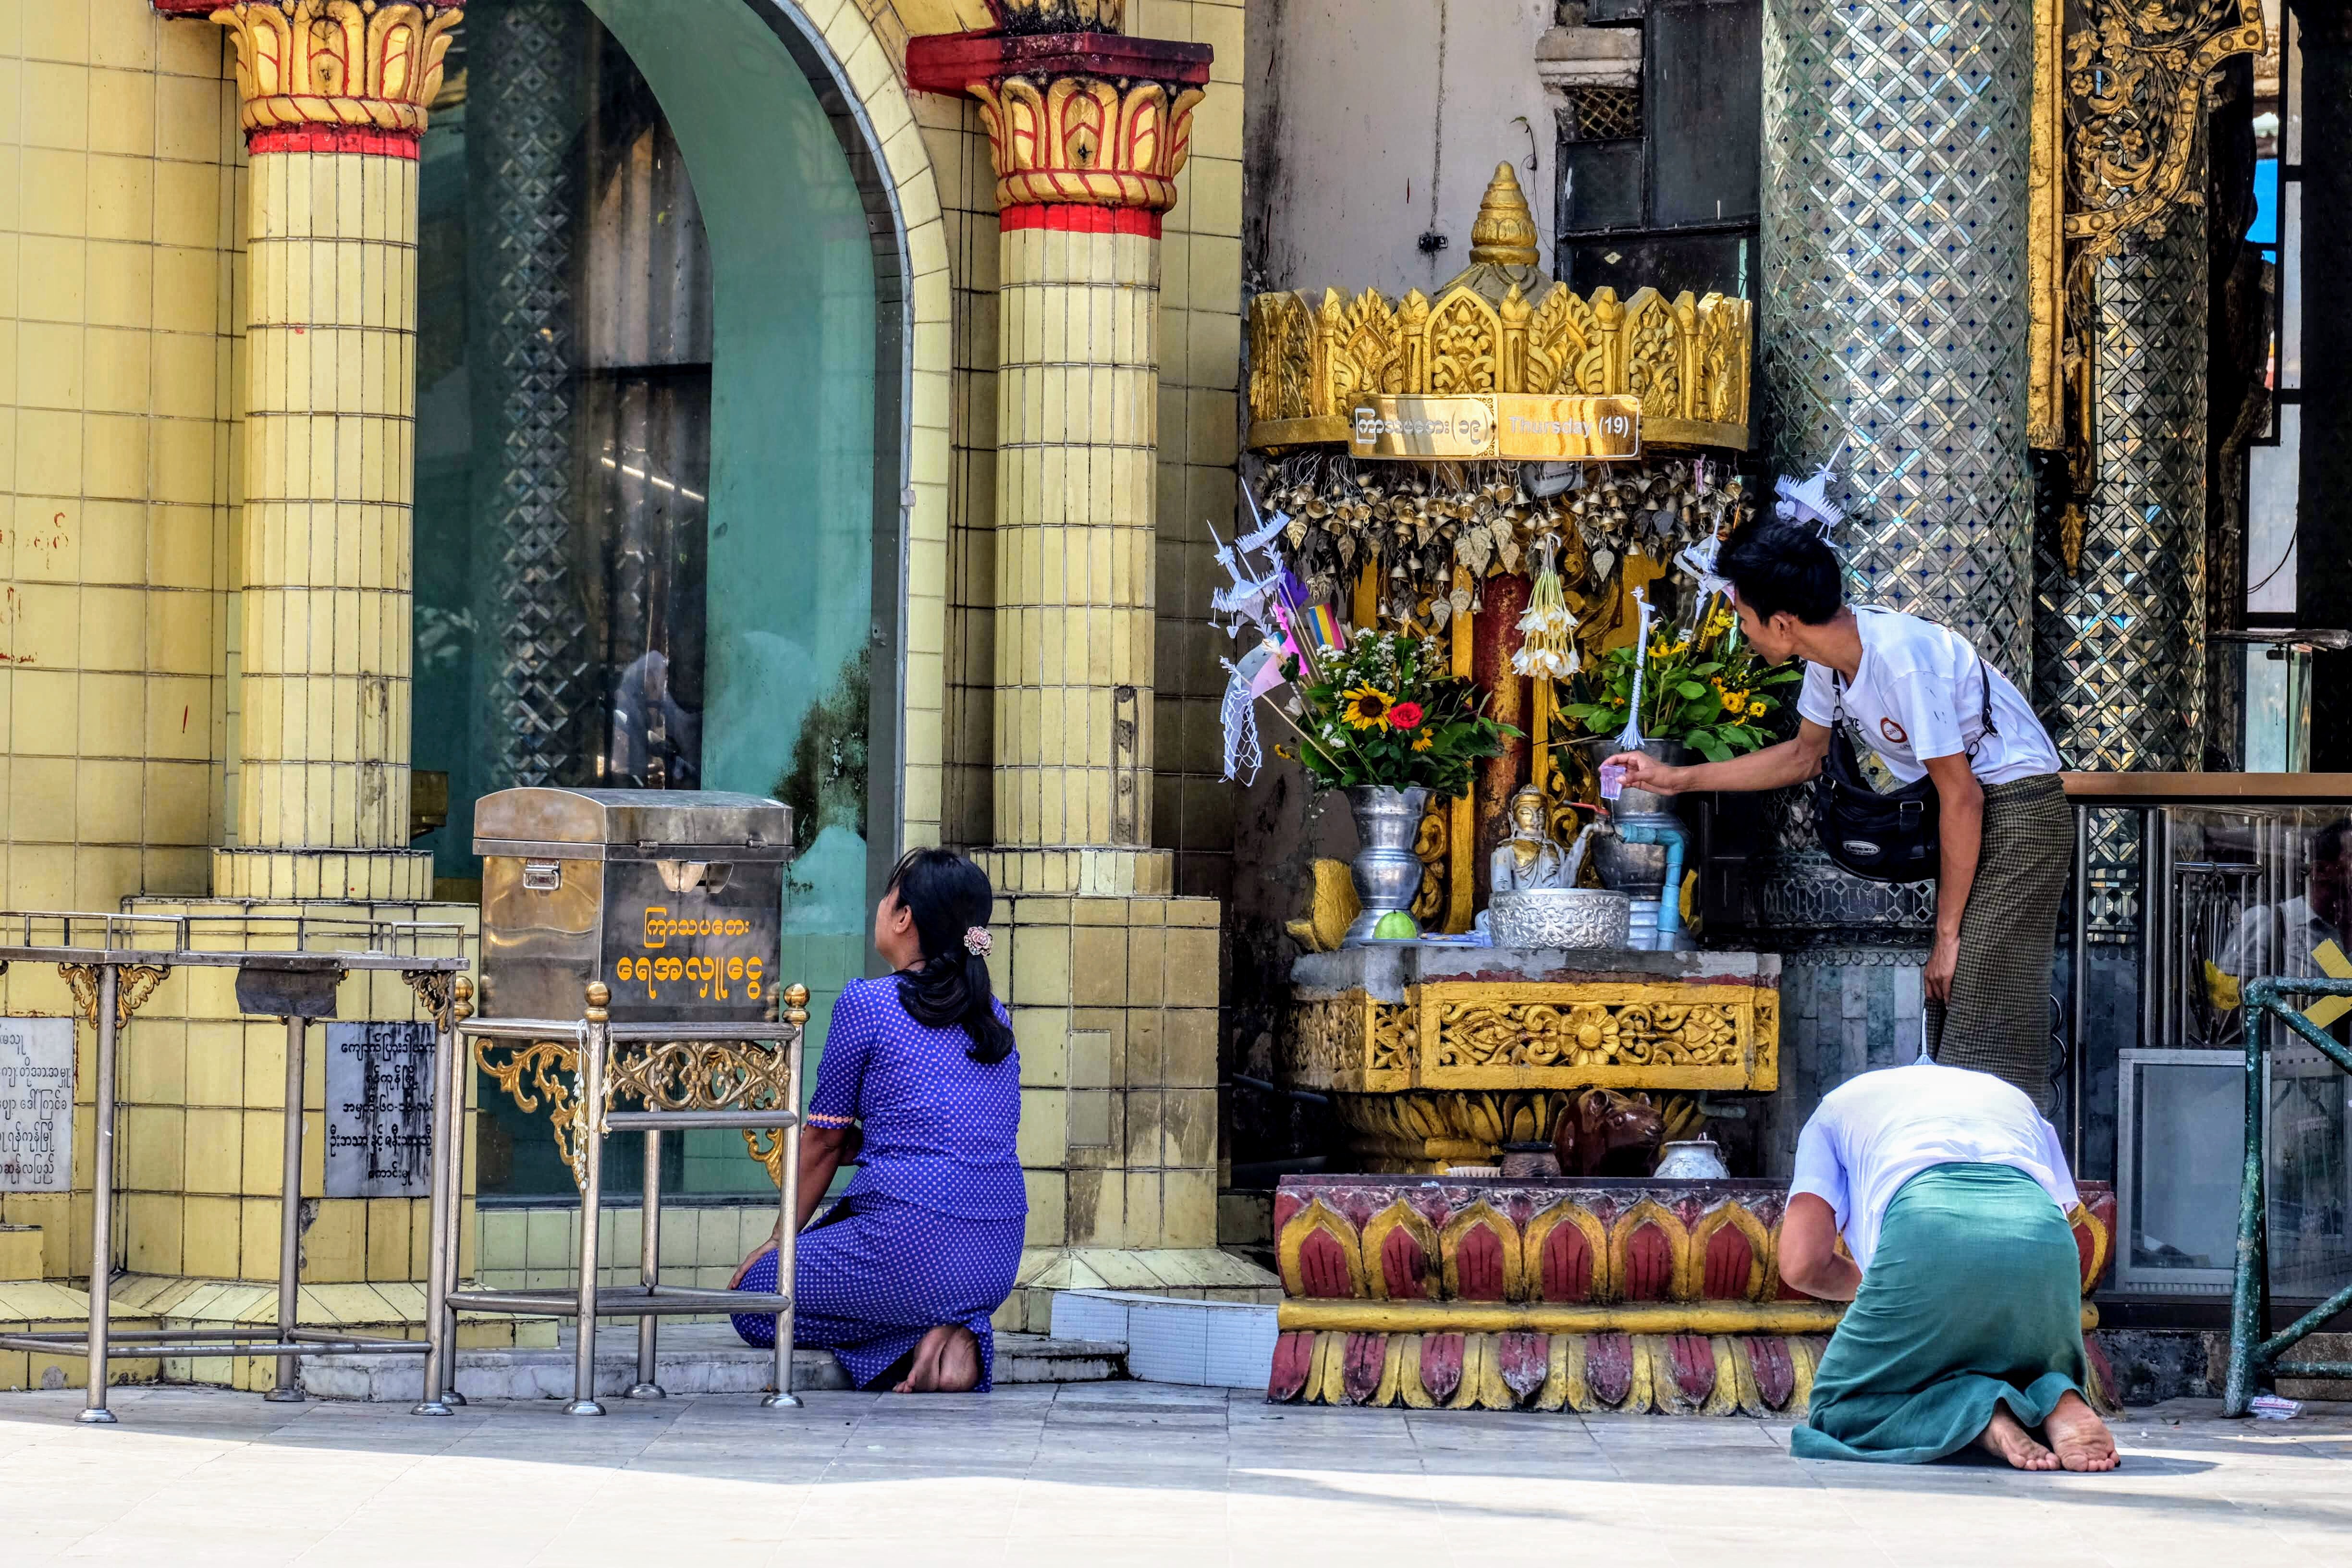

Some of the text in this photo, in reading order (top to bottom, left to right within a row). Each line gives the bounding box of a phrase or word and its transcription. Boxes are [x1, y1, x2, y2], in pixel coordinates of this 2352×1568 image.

[1509, 416, 1629, 439] Thursday (19)
[644, 906, 750, 948] ကြာသပတေး
[617, 956, 763, 1001] ရေအလှူငွေ
